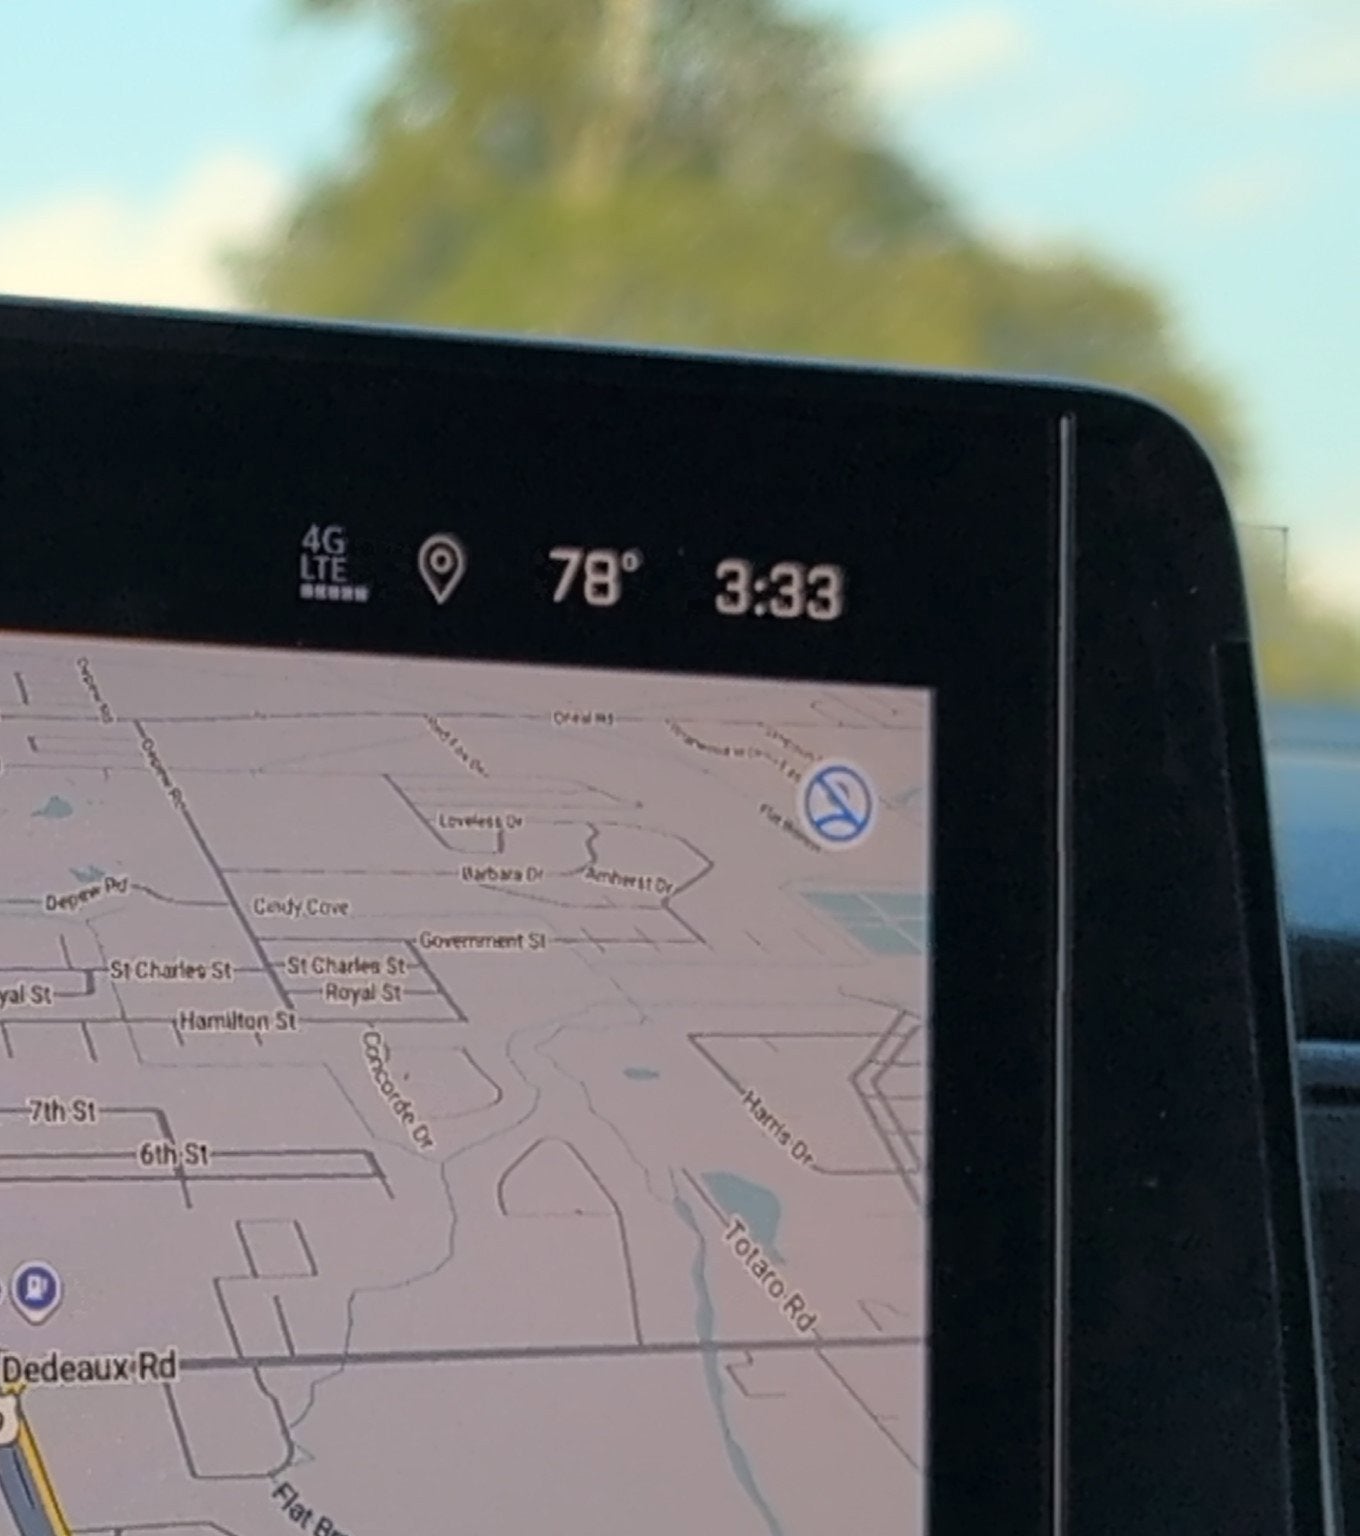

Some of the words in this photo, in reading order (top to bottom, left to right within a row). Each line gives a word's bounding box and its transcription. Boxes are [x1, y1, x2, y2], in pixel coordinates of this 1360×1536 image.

[301, 524, 346, 556] 4G
[300, 554, 348, 583] LTE
[548, 546, 641, 606] 78°
[714, 557, 843, 621] 3:33
[438, 813, 504, 829] Loveless
[507, 815, 523, 829] Dr
[461, 867, 522, 882] Barbara
[527, 868, 544, 882] Dr
[585, 867, 653, 893] Amherst
[656, 877, 674, 895] Dr
[307, 899, 350, 916] Cove
[419, 931, 525, 950] Government
[529, 933, 547, 950] St
[110, 961, 130, 980] St
[135, 961, 207, 980] Charles
[211, 961, 232, 980] St
[287, 956, 307, 974] St
[311, 956, 380, 974] Charles
[386, 956, 406, 975] St
[30, 985, 52, 1004] St
[325, 984, 376, 1006] Royal
[382, 984, 402, 1001] St
[180, 1010, 270, 1031] Hamilton
[275, 1011, 297, 1031] St
[361, 1031, 416, 1127] Concorde
[412, 1124, 434, 1149] Dr
[30, 1100, 67, 1122] 7th
[71, 1101, 96, 1121] St
[742, 1090, 791, 1146] Harris
[790, 1140, 814, 1166] Dr
[139, 1143, 178, 1166] 6th
[183, 1144, 209, 1166] St
[726, 1220, 785, 1299] Totaro
[782, 1293, 818, 1332] Rd
[1, 1356, 127, 1383] Dedeaux
[138, 1352, 178, 1381] Rd
[272, 1481, 312, 1527] Flat
